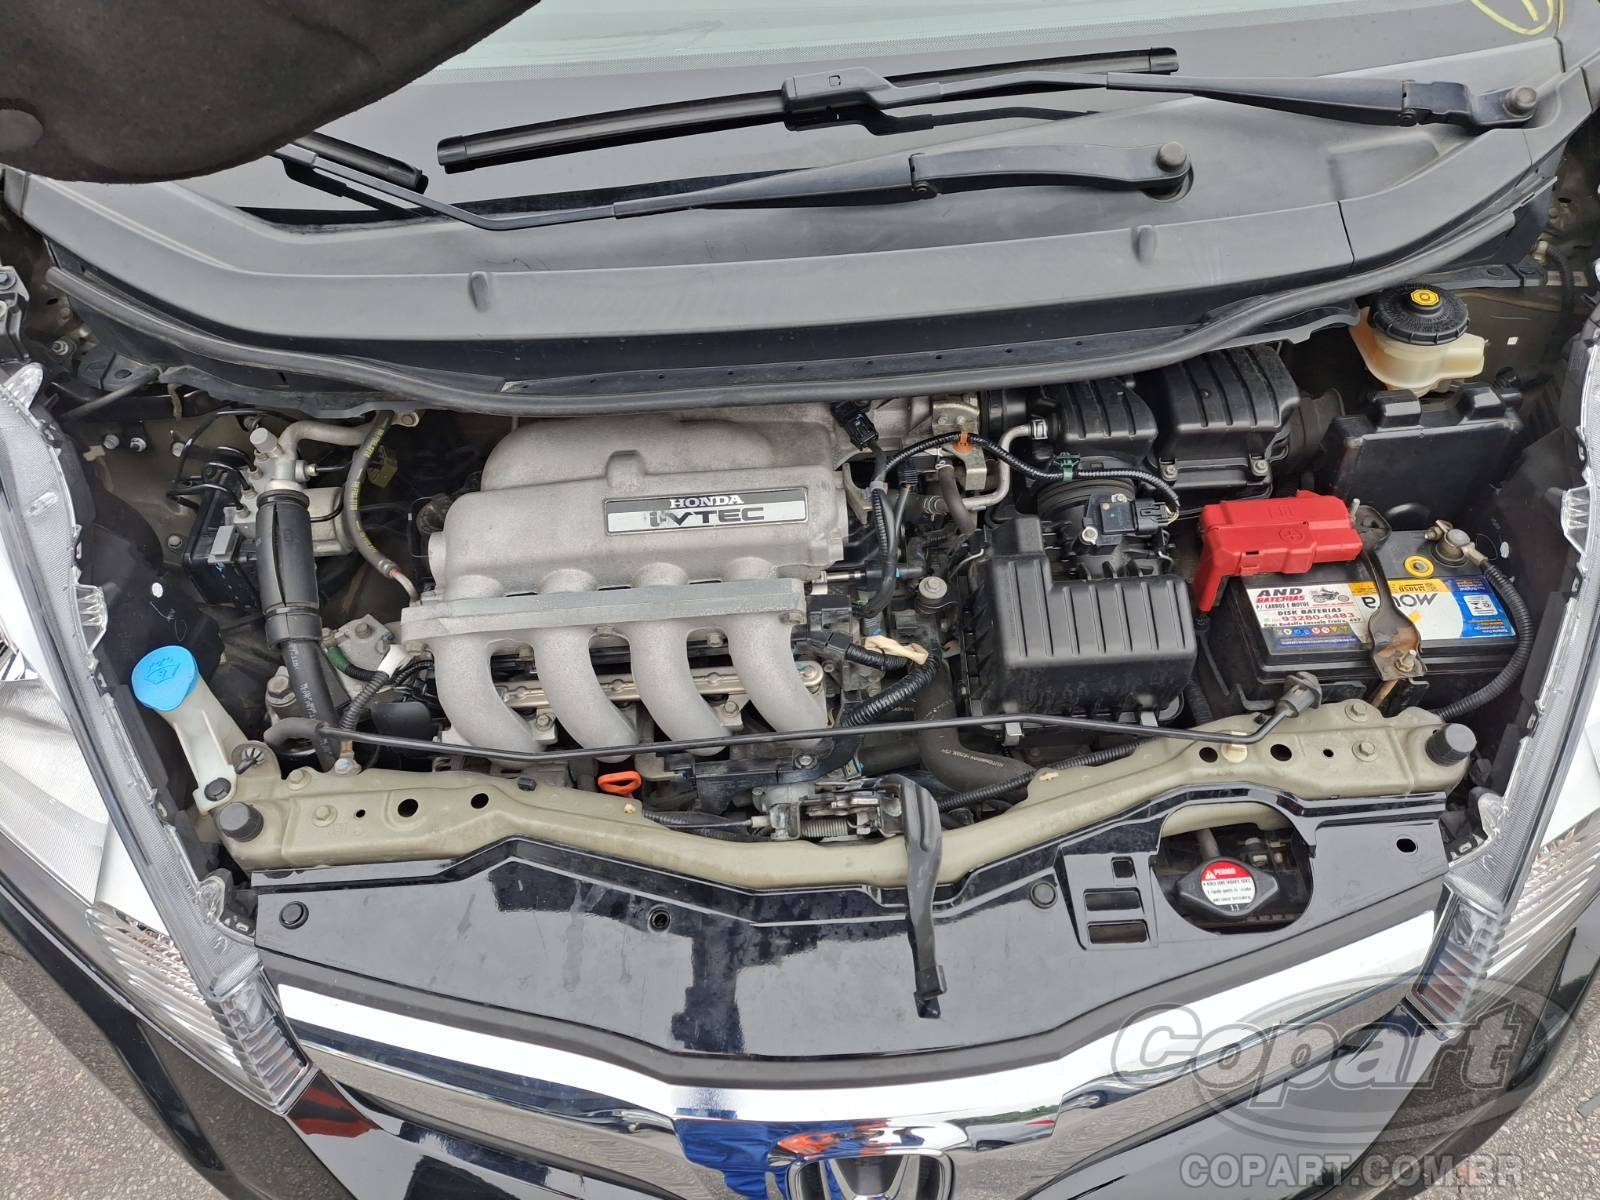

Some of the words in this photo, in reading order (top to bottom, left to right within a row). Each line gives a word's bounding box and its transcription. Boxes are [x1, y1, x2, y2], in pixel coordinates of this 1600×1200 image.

[669, 494, 744, 509] HONDA
[1257, 588, 1303, 598] AND
[1301, 607, 1343, 615] BATERIAS
[1281, 612, 1355, 622] 93280-6483
